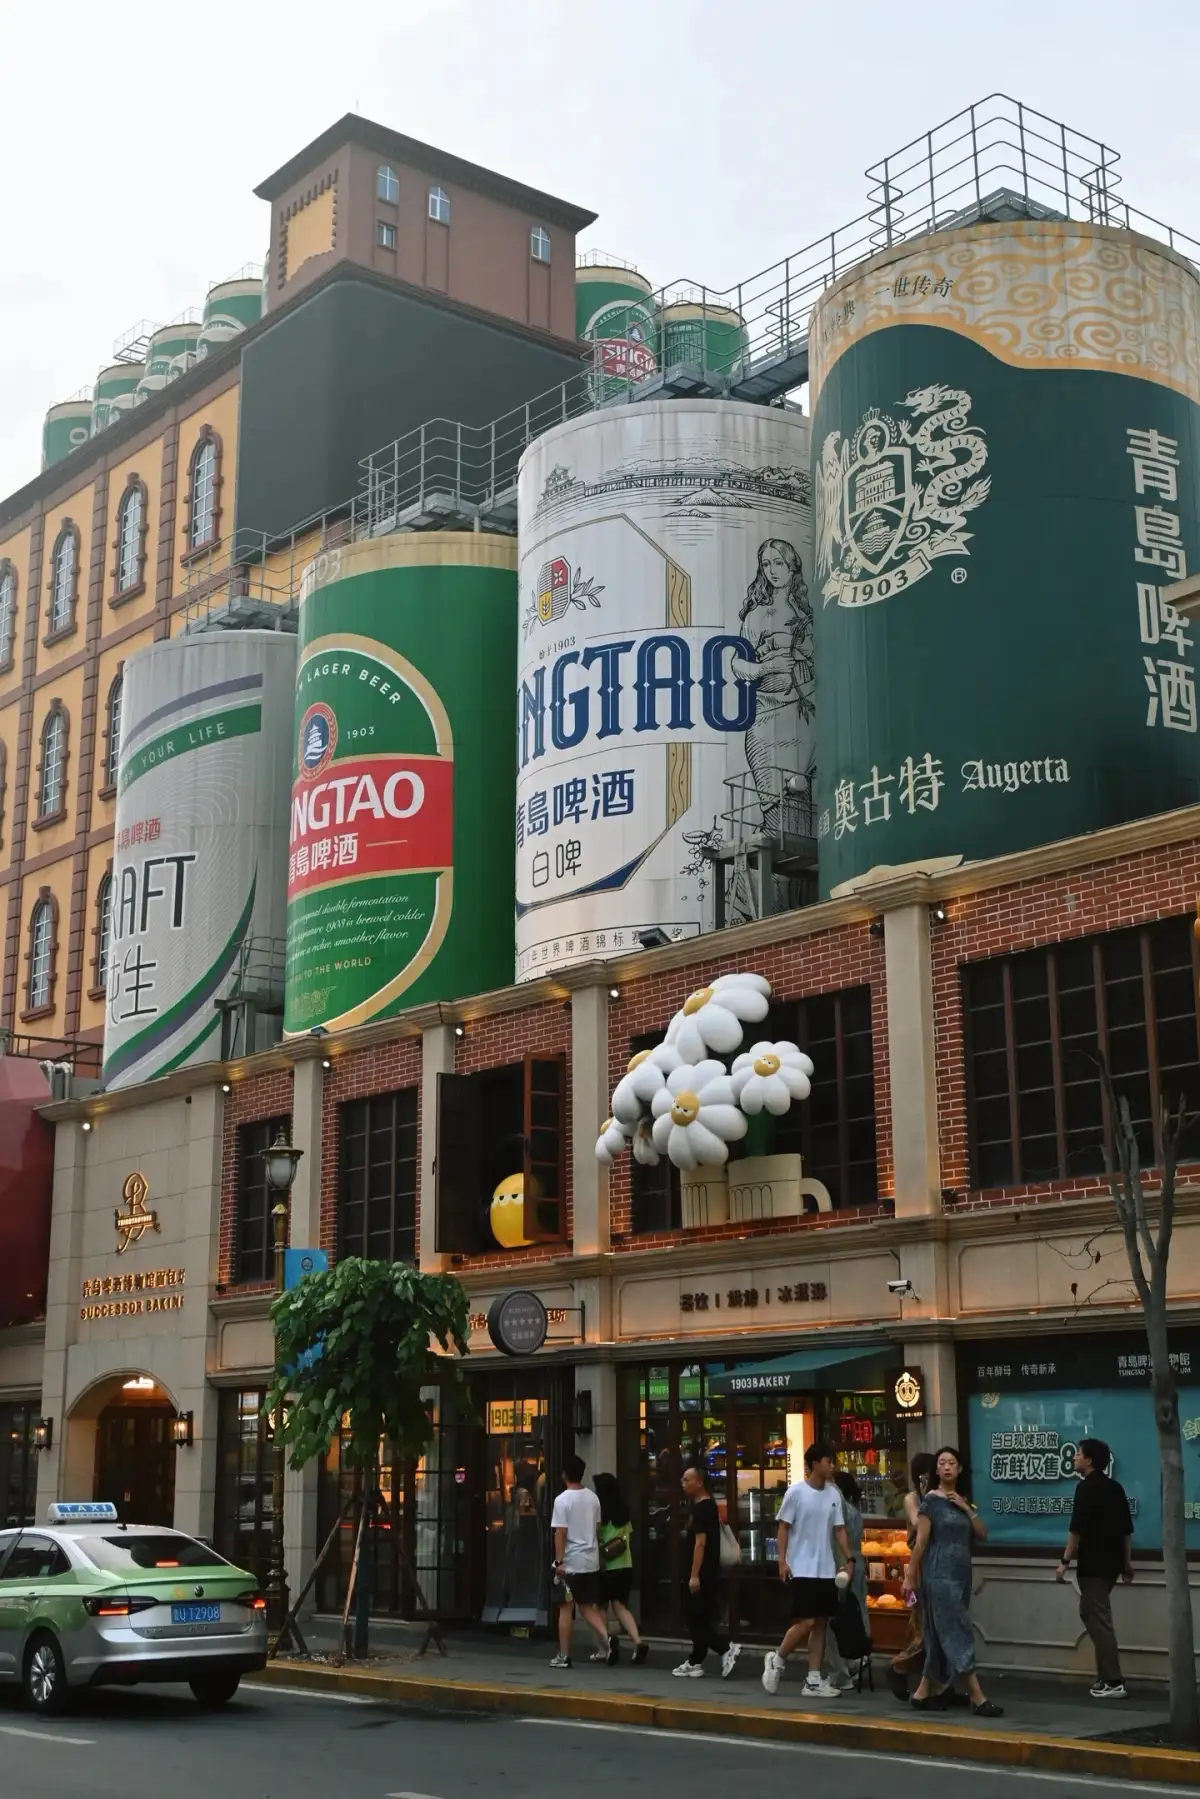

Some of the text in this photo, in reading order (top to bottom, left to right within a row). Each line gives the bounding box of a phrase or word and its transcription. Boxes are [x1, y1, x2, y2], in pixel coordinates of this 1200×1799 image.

[874, 276, 954, 298] 一世传奇
[850, 569, 909, 604] 1903
[1125, 428, 1197, 732] 青島啤酒
[307, 663, 401, 704] LAGER BEER
[347, 726, 375, 739] 1903
[141, 723, 226, 767] YOUR LIFE
[961, 756, 1070, 793] Augerta
[532, 839, 582, 888] 白啤
[345, 894, 409, 913] fermentation
[356, 910, 393, 925] brewed
[393, 907, 426, 921] colder
[334, 930, 376, 947] smoother
[315, 964, 331, 975] THE
[334, 956, 372, 971] WORLD
[80, 1300, 143, 1320] SUCCESSOR
[731, 1374, 791, 1390] 1903BAKERY
[991, 1431, 1059, 1449] 当日现烤现做
[64, 1504, 108, 1512] TAXI
